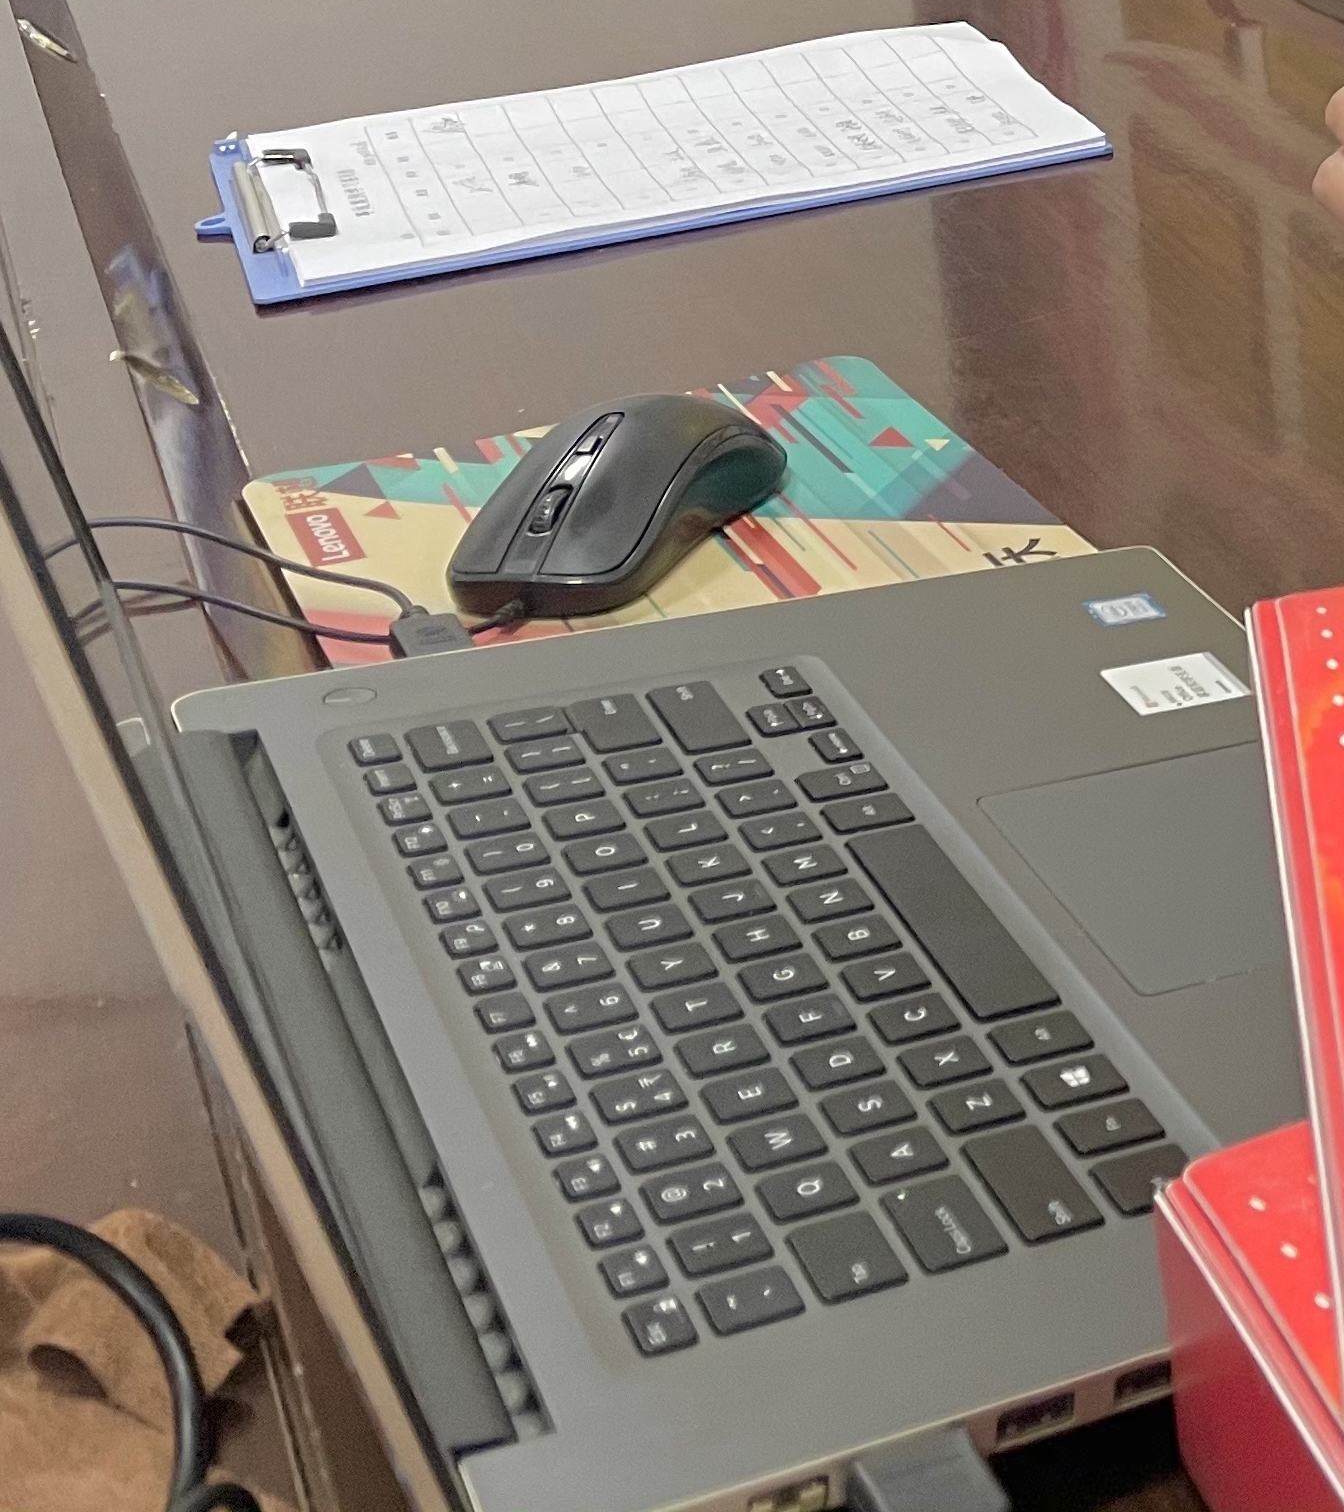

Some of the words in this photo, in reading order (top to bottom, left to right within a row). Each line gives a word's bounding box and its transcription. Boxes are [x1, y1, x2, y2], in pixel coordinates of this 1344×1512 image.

[305, 514, 350, 562] Lenovo
[575, 813, 595, 822] P
[678, 823, 697, 833] L
[595, 845, 617, 856] O
[698, 856, 720, 868] K
[794, 856, 817, 869] M
[536, 877, 554, 888] 9
[722, 892, 744, 901] J
[820, 890, 843, 904] N
[556, 914, 577, 925] 8
[638, 918, 661, 930] U
[746, 929, 769, 942] H
[848, 928, 870, 940] B
[577, 956, 598, 965] 7
[661, 959, 683, 970] Y
[773, 967, 795, 981] G
[874, 969, 895, 981] V
[600, 995, 620, 1006] 6
[685, 1000, 707, 1011] T
[799, 1012, 822, 1023] F
[904, 1008, 926, 1021] C
[713, 1041, 736, 1054] R
[829, 1052, 853, 1068] D
[934, 1051, 958, 1066] X
[738, 1084, 762, 1100] E
[858, 1097, 882, 1112] S
[966, 1094, 992, 1111] Z
[674, 1129, 696, 1142] 3
[764, 1130, 793, 1150] W
[891, 1143, 914, 1157] A
[703, 1177, 725, 1191] 2
[797, 1178, 822, 1196] Q
